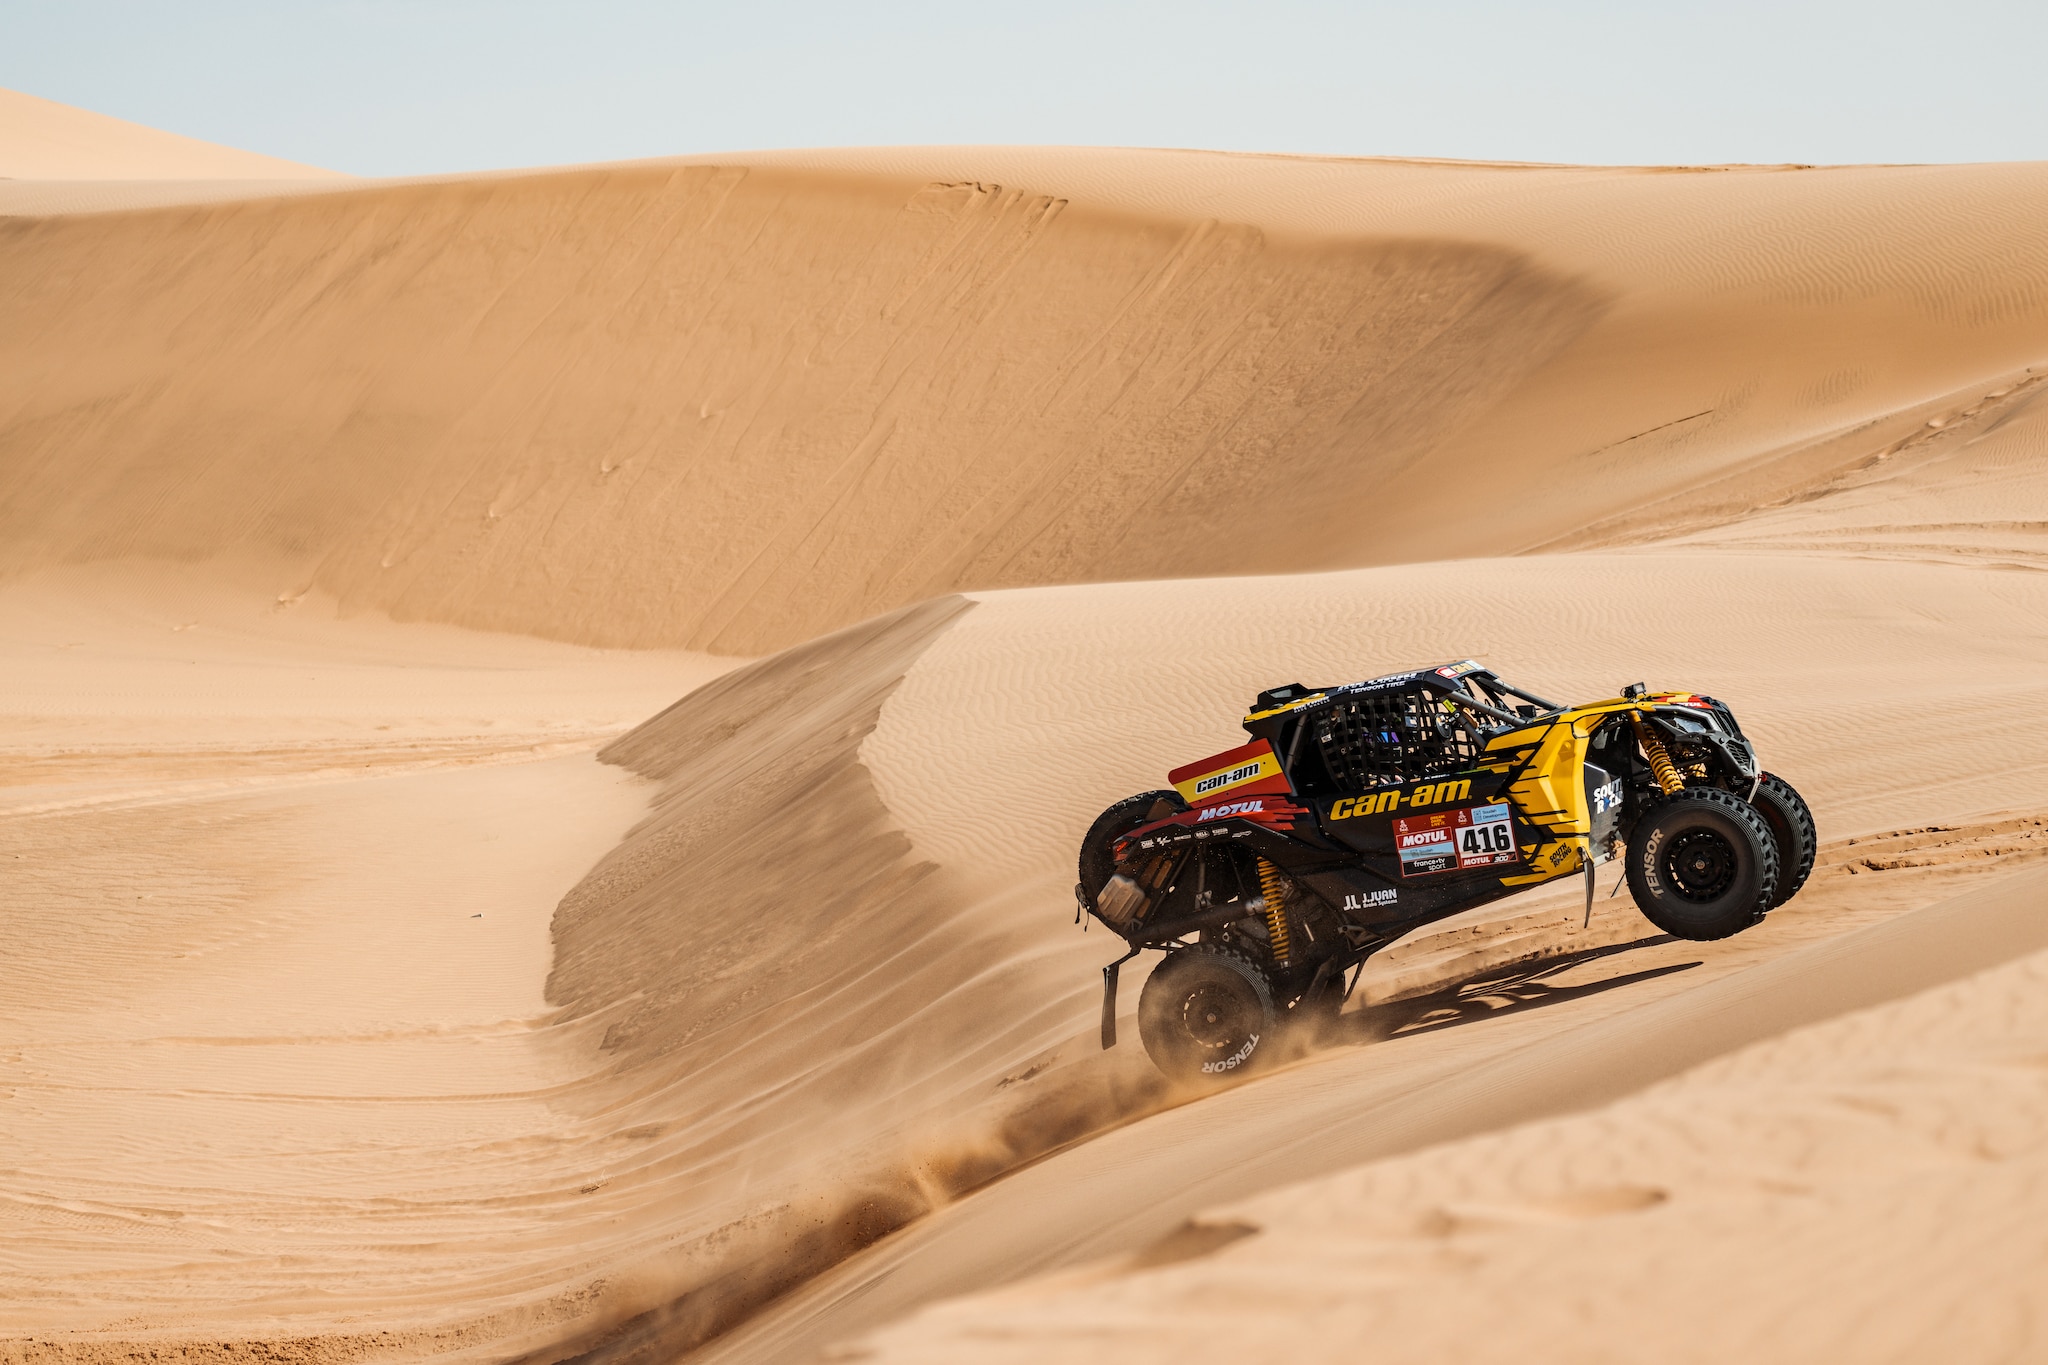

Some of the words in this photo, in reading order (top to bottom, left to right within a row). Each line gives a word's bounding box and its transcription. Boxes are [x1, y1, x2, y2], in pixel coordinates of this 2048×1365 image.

[1196, 763, 1260, 793] can-am
[1197, 800, 1264, 822] MOTUL
[1330, 779, 1472, 821] can-am
[1403, 830, 1448, 847] MOTUL
[1463, 824, 1511, 854] 416
[1463, 856, 1491, 866] MOTUL
[1549, 842, 1567, 863] SOUTH
[1643, 828, 1665, 899] TENSOR
[1428, 863, 1447, 871] sport
[1201, 1033, 1260, 1074] TENSOR
